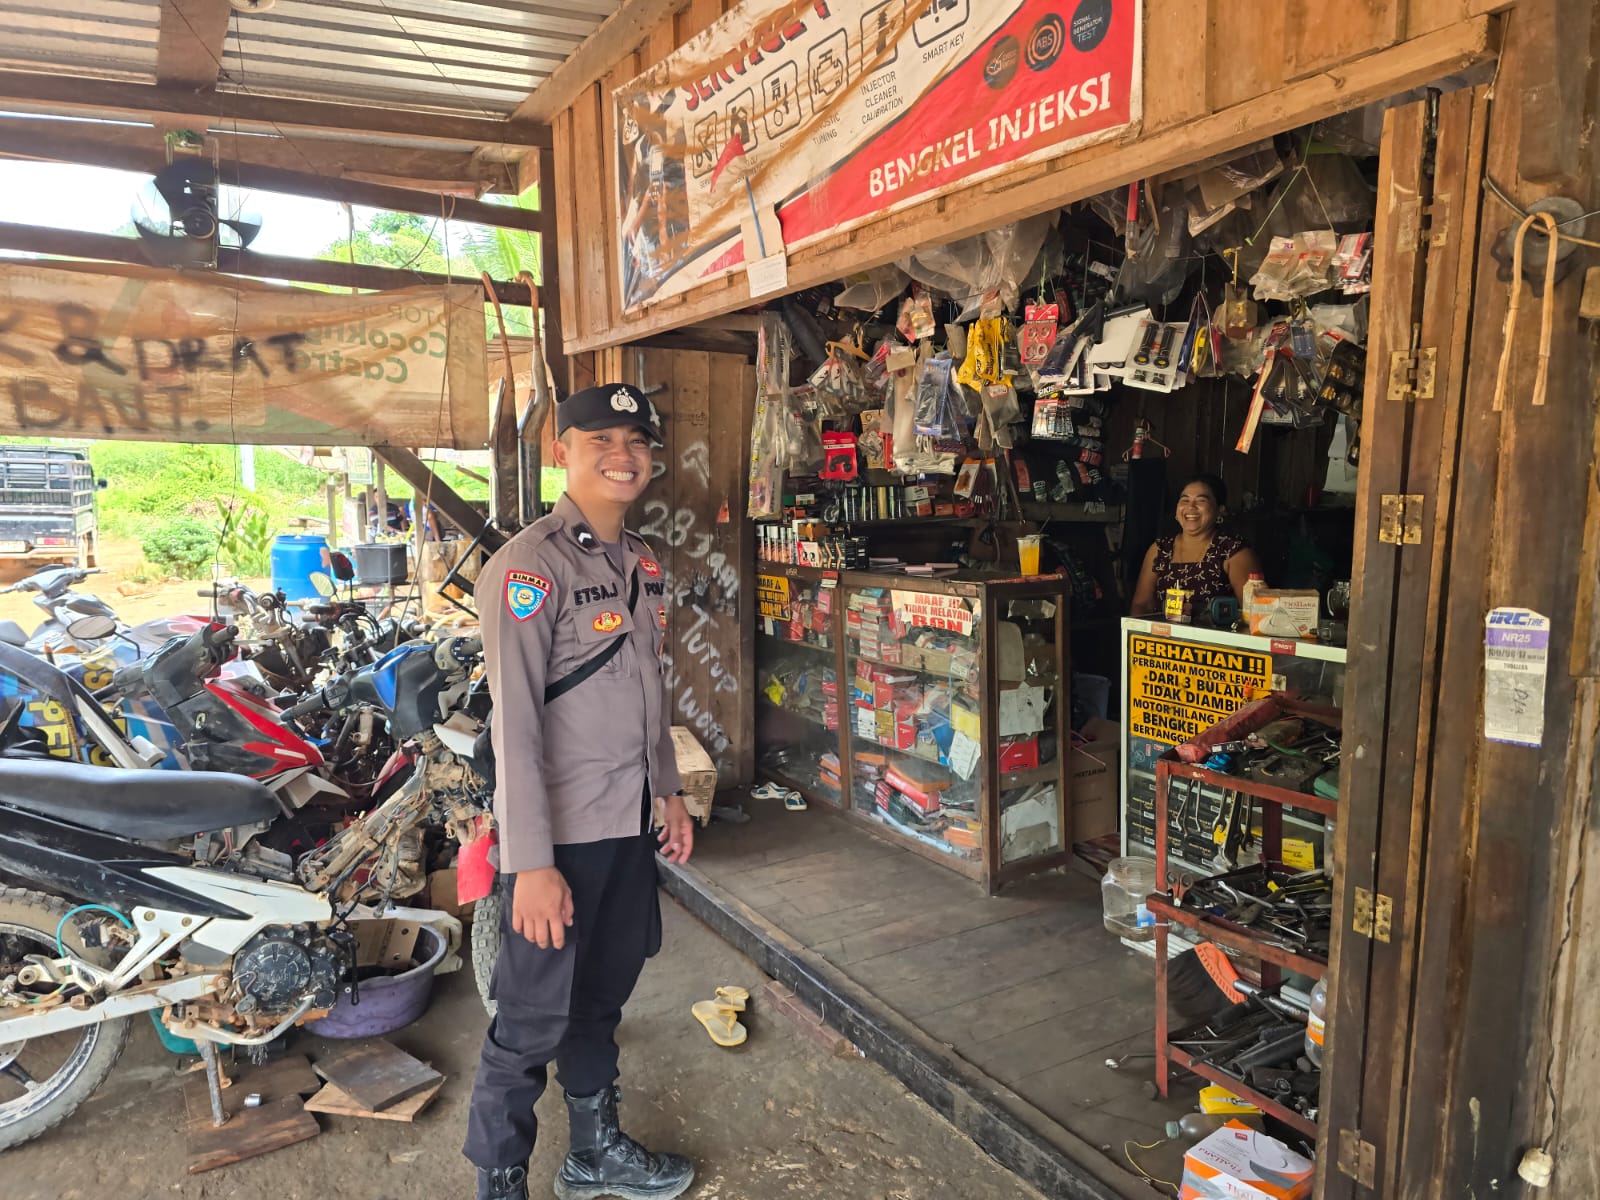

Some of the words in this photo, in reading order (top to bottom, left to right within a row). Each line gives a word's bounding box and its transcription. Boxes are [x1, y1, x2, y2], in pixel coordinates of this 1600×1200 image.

[1036, 33, 1054, 50] ABS
[1077, 27, 1097, 44] TEST
[922, 40, 948, 64] SMART
[950, 32, 966, 49] KEY
[861, 70, 896, 95] INJECTOR
[865, 85, 897, 108] CLEANER
[861, 96, 904, 126] CALIBRATION
[812, 128, 838, 145] TUNING
[869, 128, 981, 198] BENGKEL
[988, 72, 1112, 152] INJEKSI
[512, 574, 547, 588] BINMAS
[914, 594, 944, 606] MAAF
[904, 604, 927, 616] TIDAK
[930, 606, 972, 622] MELAYANI
[912, 614, 963, 632] BON
[1502, 632, 1532, 644] NR25
[1134, 640, 1243, 670] PERHATIAN
[1248, 658, 1264, 674] !!
[1132, 656, 1187, 674] PERBAIKAN
[1189, 666, 1226, 682] MOTOR
[1230, 672, 1266, 690] LEWAT
[1148, 670, 1180, 686] DARI
[1184, 678, 1192, 690] 3
[1196, 679, 1244, 698] BULAN
[1142, 682, 1182, 702] TIDAK
[1133, 698, 1171, 714] MOTOR
[1172, 705, 1214, 724] HILANG
[1133, 722, 1192, 744] BERTANGGU
[1142, 712, 1200, 736] BENGKEL
